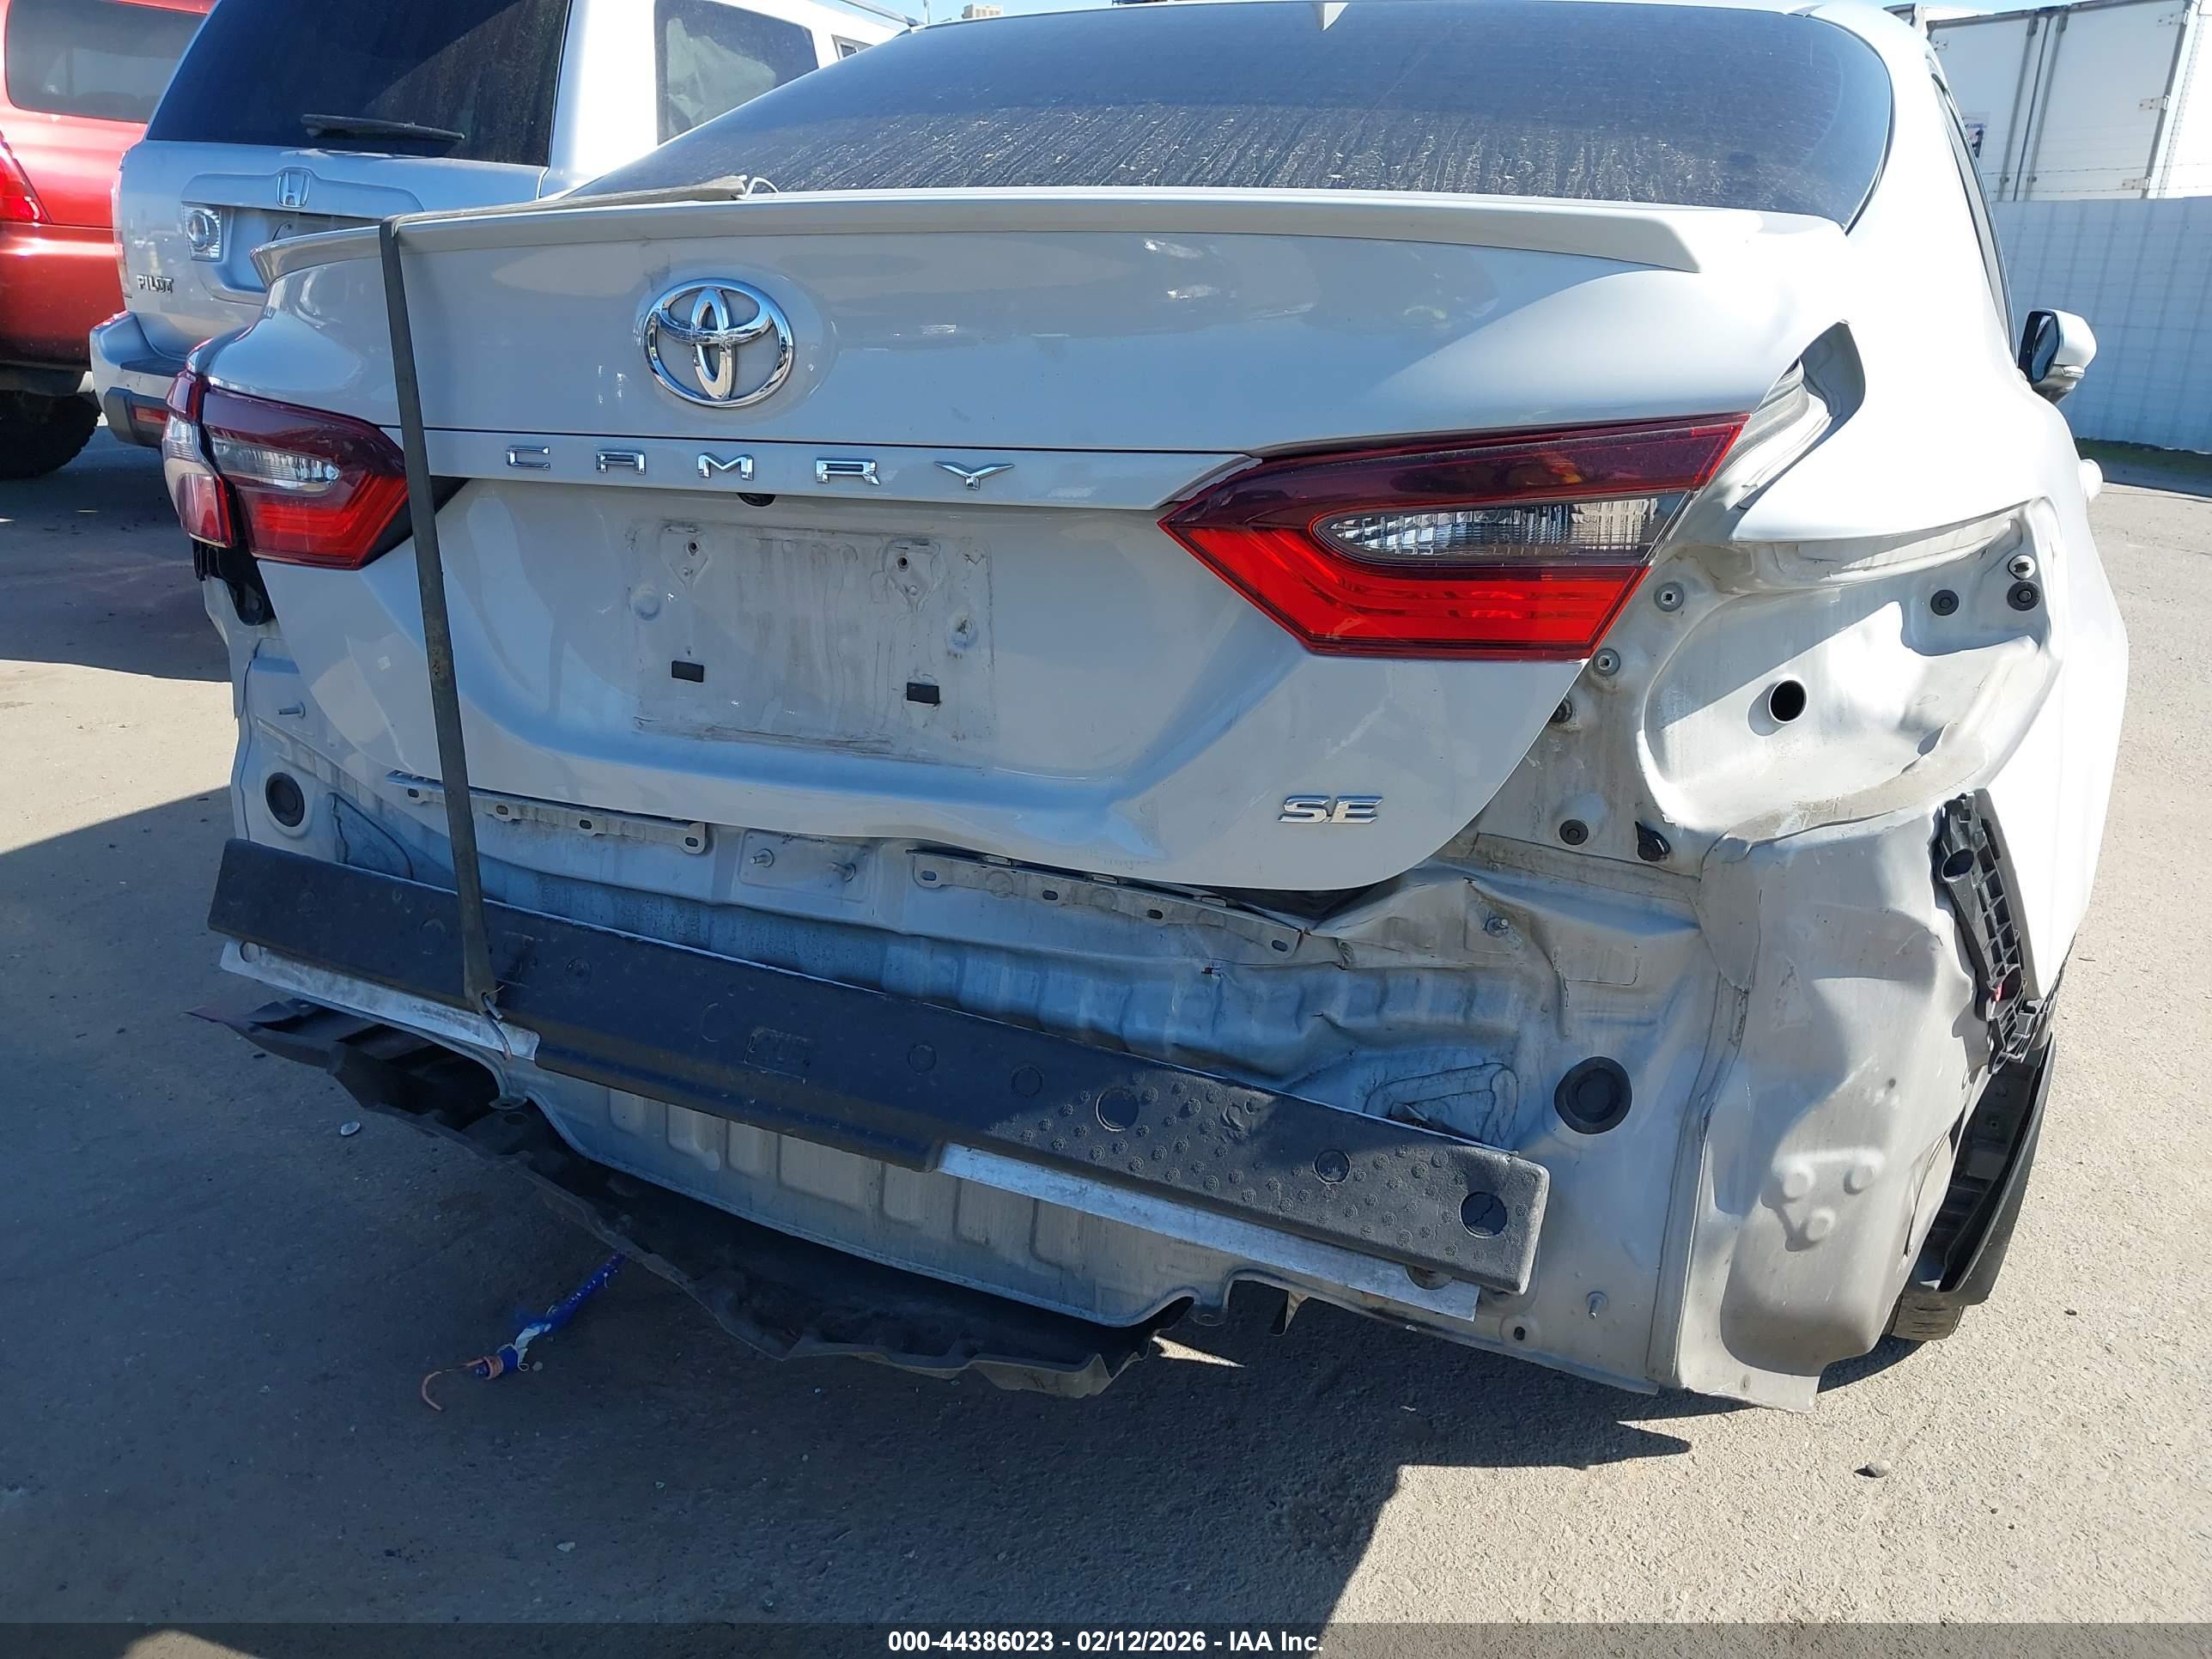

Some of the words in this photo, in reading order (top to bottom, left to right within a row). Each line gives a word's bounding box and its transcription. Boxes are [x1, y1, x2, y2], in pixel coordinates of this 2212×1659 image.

[137, 274, 173, 293] PILOT
[505, 444, 1015, 491] CAMRY
[1277, 795, 1383, 823] SE
